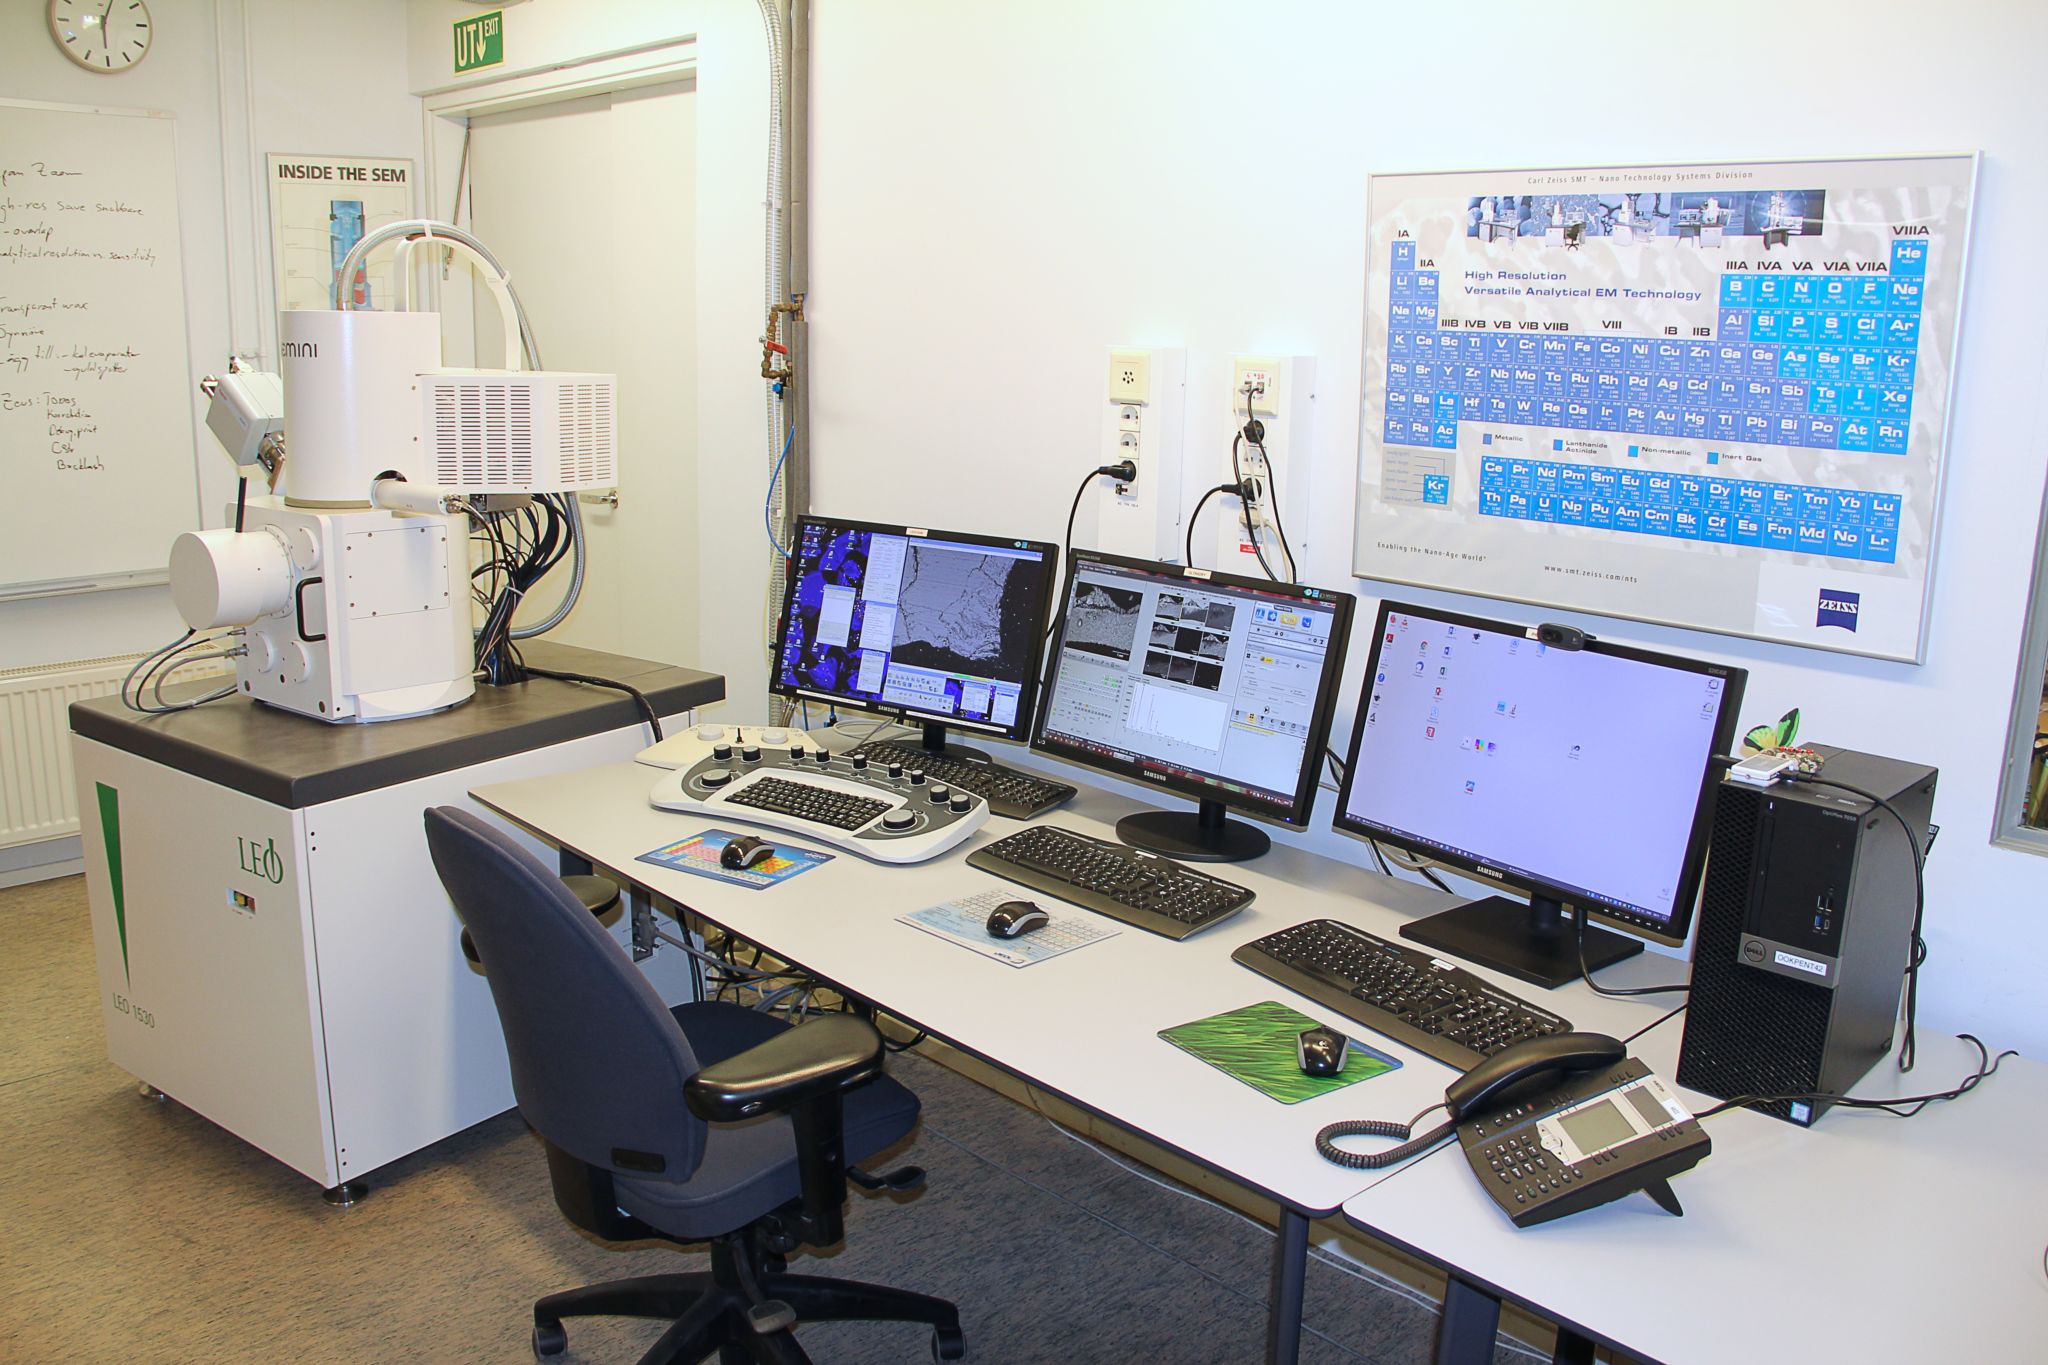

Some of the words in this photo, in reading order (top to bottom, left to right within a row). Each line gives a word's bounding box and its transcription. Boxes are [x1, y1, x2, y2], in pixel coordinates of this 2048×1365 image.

[485, 17, 498, 37] EXIT
[457, 24, 476, 66] UT
[279, 165, 332, 179] INSIDE
[337, 167, 367, 181] THE
[372, 169, 406, 182] SEM
[1624, 173, 1671, 182] Technology
[1677, 172, 1711, 181] Systems
[1716, 171, 1752, 179] Division
[1893, 226, 1929, 235] VIIIA
[1398, 248, 1407, 256] H
[1897, 247, 1921, 258] He
[1726, 261, 1748, 270] IIIA
[1757, 262, 1782, 270] IVA
[1792, 262, 1813, 270] VA
[1823, 262, 1850, 271] VIA
[1856, 262, 1887, 271] VIIA
[1465, 271, 1493, 280] High
[1498, 272, 1566, 280] Resolution
[1419, 277, 1434, 286] Be
[1730, 281, 1741, 291] B
[1762, 282, 1774, 292] C
[1794, 282, 1808, 292] N
[1828, 283, 1842, 293] O
[1864, 283, 1874, 293] F
[1893, 284, 1918, 295] Ne
[1465, 287, 1521, 296] Versatile
[1526, 288, 1591, 297] Analytical
[1596, 289, 1617, 297] EM
[1624, 289, 1701, 301] Technology
[1392, 306, 1409, 315] Na
[1416, 307, 1435, 317] Mg
[1758, 315, 1774, 326] Si
[1792, 316, 1804, 326] P
[1826, 318, 1838, 328] S
[1857, 319, 1874, 329] Cl
[1890, 320, 1913, 331] Ar
[1441, 320, 1458, 328] IIIB
[1465, 320, 1485, 328] IVB
[1494, 321, 1511, 329] VB
[1519, 321, 1538, 329] VIB
[1543, 322, 1568, 331] VIIB
[1602, 321, 1621, 329] VIII
[1665, 327, 1677, 335] IB
[1693, 328, 1710, 336] IIB
[1395, 335, 1404, 344] K
[1496, 339, 1506, 347] V
[1519, 340, 1535, 349] Cr
[1544, 342, 1565, 351] Mn
[1575, 342, 1590, 352] Fe
[1600, 343, 1620, 353] Co
[1632, 344, 1648, 354] Ni
[1660, 346, 1680, 356] Cu
[1690, 347, 1710, 357] Zn
[1721, 348, 1741, 359] Ga
[1752, 350, 1773, 360] Ge
[1784, 351, 1806, 362] As
[1818, 353, 1839, 364] Se
[1852, 354, 1874, 365] Br
[1887, 356, 1910, 367] Kr
[1466, 368, 1480, 377] Zr
[1491, 369, 1509, 378] Nb
[1516, 371, 1535, 380] Mo
[1546, 372, 1561, 381] Tc
[1572, 374, 1589, 383] Ru
[1599, 374, 1618, 385] Rh
[1629, 377, 1648, 387] Pd
[1657, 378, 1678, 390] Ag
[1687, 380, 1707, 390] Cd
[1721, 382, 1734, 392] In
[1750, 384, 1770, 394] Sn
[1781, 385, 1803, 396] Sb
[1817, 387, 1835, 398] Te
[1884, 391, 1906, 402] Xe
[1464, 397, 1479, 407] Hf
[1517, 401, 1530, 410] W
[1543, 403, 1560, 412] Re
[1569, 405, 1587, 415] Os
[1601, 406, 1612, 416] Ir
[1627, 408, 1644, 418] Pt
[1655, 411, 1675, 420] Au
[1684, 413, 1705, 425] Hg
[1747, 417, 1767, 428] Pb
[1781, 419, 1797, 430] Bi
[1811, 421, 1833, 432] Po
[1845, 424, 1868, 435] At
[1879, 426, 1903, 437] Rn
[1641, 446, 1691, 456] Non-metallic
[1538, 467, 1556, 477] Nd
[1563, 470, 1585, 480] Pm
[1591, 472, 1613, 483] Sm
[1622, 475, 1639, 486] Eu
[1650, 478, 1670, 488] Gd
[1681, 481, 1699, 491] Tb
[1710, 484, 1730, 496] Dy
[1740, 487, 1762, 498] Ho
[1773, 490, 1792, 501] Er
[1803, 493, 1828, 504] Tm
[1838, 496, 1860, 508] Yb
[1873, 500, 1893, 511] Lu
[1539, 498, 1549, 507] U
[1562, 501, 1582, 512] Np
[1591, 503, 1609, 514] Pu
[1616, 506, 1640, 517] Am
[1645, 510, 1670, 521] Cm
[1677, 513, 1696, 525] Bk
[1708, 517, 1726, 527] Cf
[1738, 520, 1757, 531] Es
[1768, 524, 1792, 535] Fm
[1800, 527, 1825, 539] Md
[1834, 530, 1857, 542] No
[1871, 534, 1889, 545] Lr
[1378, 542, 1407, 552] Enabling
[1425, 549, 1458, 559] Nano-Age
[1544, 565, 1638, 583] www.smt.zeiss.com/nts
[1820, 599, 1857, 613] ZEISS
[1144, 770, 1166, 781] SAMSUNG
[237, 836, 283, 884] LEO
[1476, 866, 1503, 878] SAMSUNG
[1746, 948, 1763, 956] DELL
[1778, 954, 1824, 973] OOKPENT42
[113, 992, 129, 1015] LEO
[133, 1005, 155, 1028] 1530
